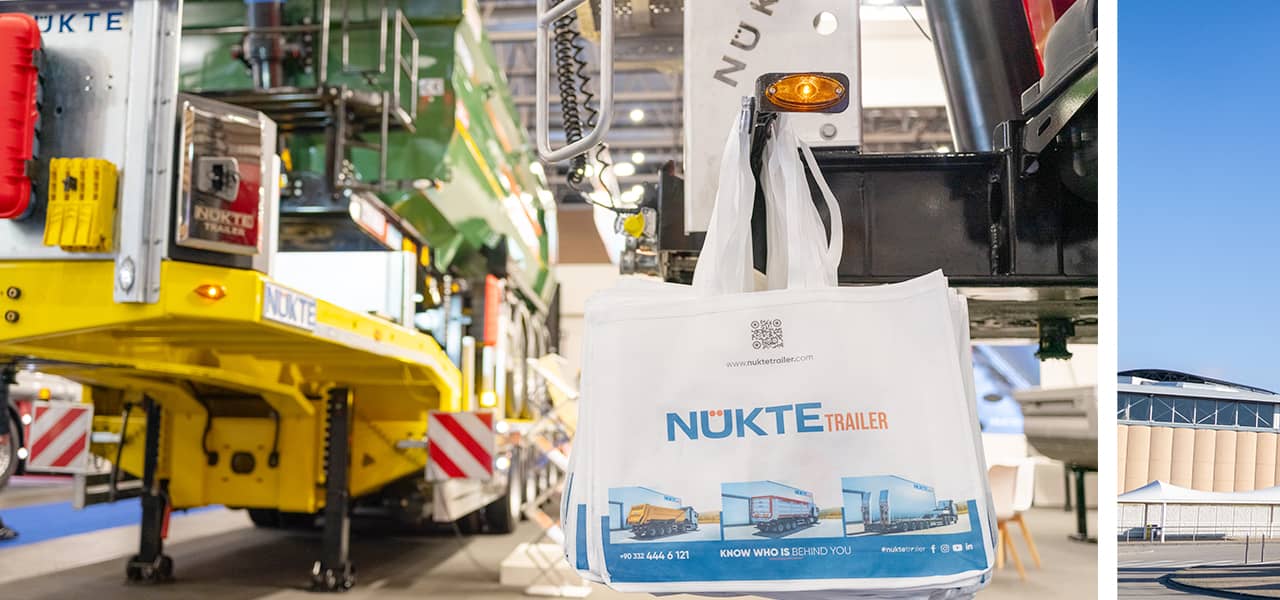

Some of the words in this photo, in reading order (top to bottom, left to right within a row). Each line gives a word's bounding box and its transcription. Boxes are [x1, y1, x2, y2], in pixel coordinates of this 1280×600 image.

[34, 11, 124, 32] ÜKTE
[204, 222, 246, 237] TRAILER
[726, 354, 814, 368] www.nuktetrailer.com
[666, 402, 824, 441] NÜKTE
[824, 411, 888, 432] TRAILER
[646, 552, 665, 560] 444
[667, 551, 673, 560] 6
[676, 550, 690, 560] 121
[720, 549, 751, 558] KNOW
[754, 548, 777, 557] WHO
[781, 548, 790, 557] IS
[792, 547, 828, 557] BEHIND
[831, 545, 852, 556] YOU
